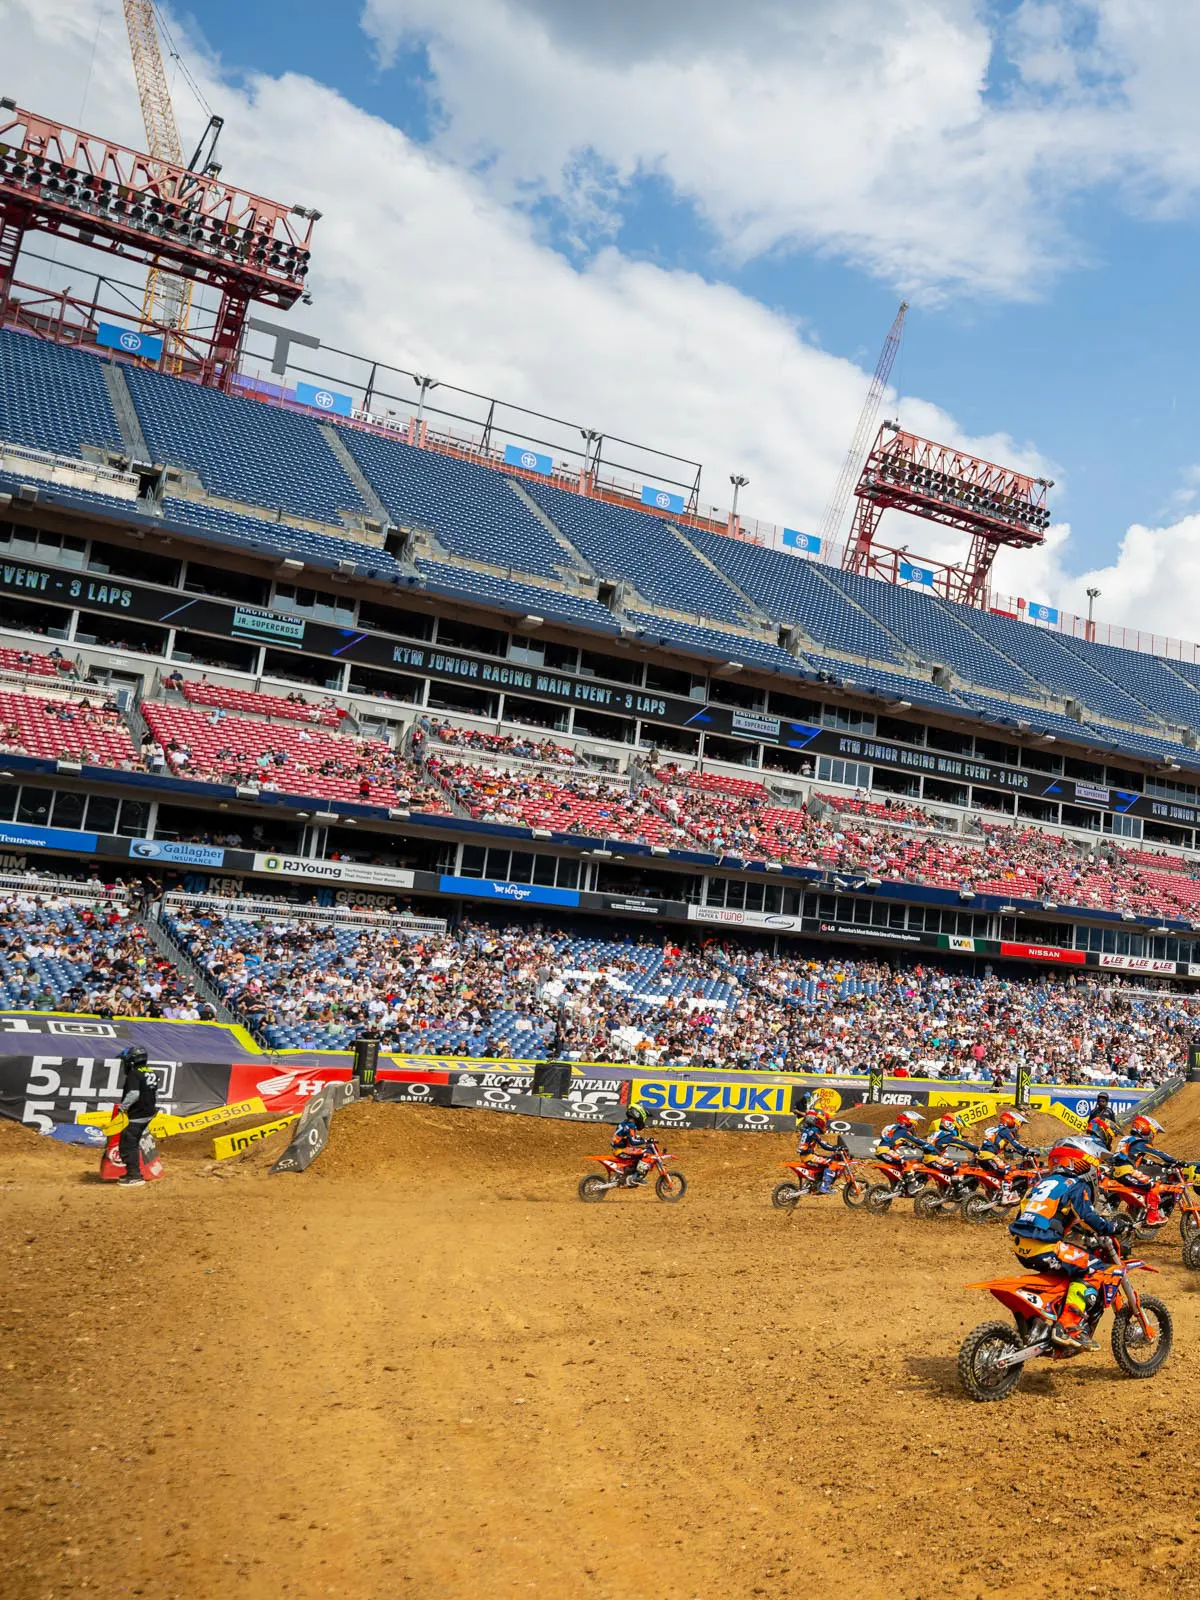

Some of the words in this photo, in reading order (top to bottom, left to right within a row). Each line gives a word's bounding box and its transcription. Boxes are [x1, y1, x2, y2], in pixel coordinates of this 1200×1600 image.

[0, 565, 51, 591] VENT
[70, 580, 82, 597] 3
[88, 583, 132, 607] LAPS
[252, 619, 299, 635] SUPERCROSS
[393, 646, 424, 666] KTM
[428, 653, 479, 678] JUNIOR
[482, 664, 533, 688] RACING
[536, 675, 571, 696] MAIN
[575, 683, 612, 704] EVENT
[625, 693, 633, 708] 3
[636, 696, 666, 715] LAPS
[840, 738, 861, 754] KTM
[864, 743, 898, 762] JUNIOR
[901, 750, 935, 769] RACING
[938, 758, 962, 775] MAIN
[965, 763, 991, 780] EVENT
[1000, 770, 1006, 784] 3
[1008, 772, 1029, 788] LAPS
[1170, 806, 1195, 822] JUNIOR
[0, 833, 47, 847] Tennessee
[163, 844, 223, 860] Gallagher
[171, 855, 212, 865] INSURANCE
[283, 860, 342, 879] RJYoung
[208, 877, 243, 892] KEN
[504, 883, 532, 900] Kroger
[1028, 948, 1060, 959] NISSAN
[1111, 956, 1125, 964] LEE
[1136, 959, 1149, 967] LEE
[1160, 962, 1173, 970] LEE
[26, 1055, 124, 1098] 5.11
[480, 1073, 535, 1088] ROCKY
[401, 1094, 435, 1103] OAKLEY
[476, 1099, 517, 1111] OAKLEY
[639, 1083, 785, 1113] SUZUKI
[178, 1102, 251, 1132] Insta360
[564, 1111, 605, 1120] OAKLEY
[652, 1119, 692, 1128] OAKLEY
[737, 1123, 775, 1131] OAKLEY
[1030, 1179, 1060, 1203] 3
